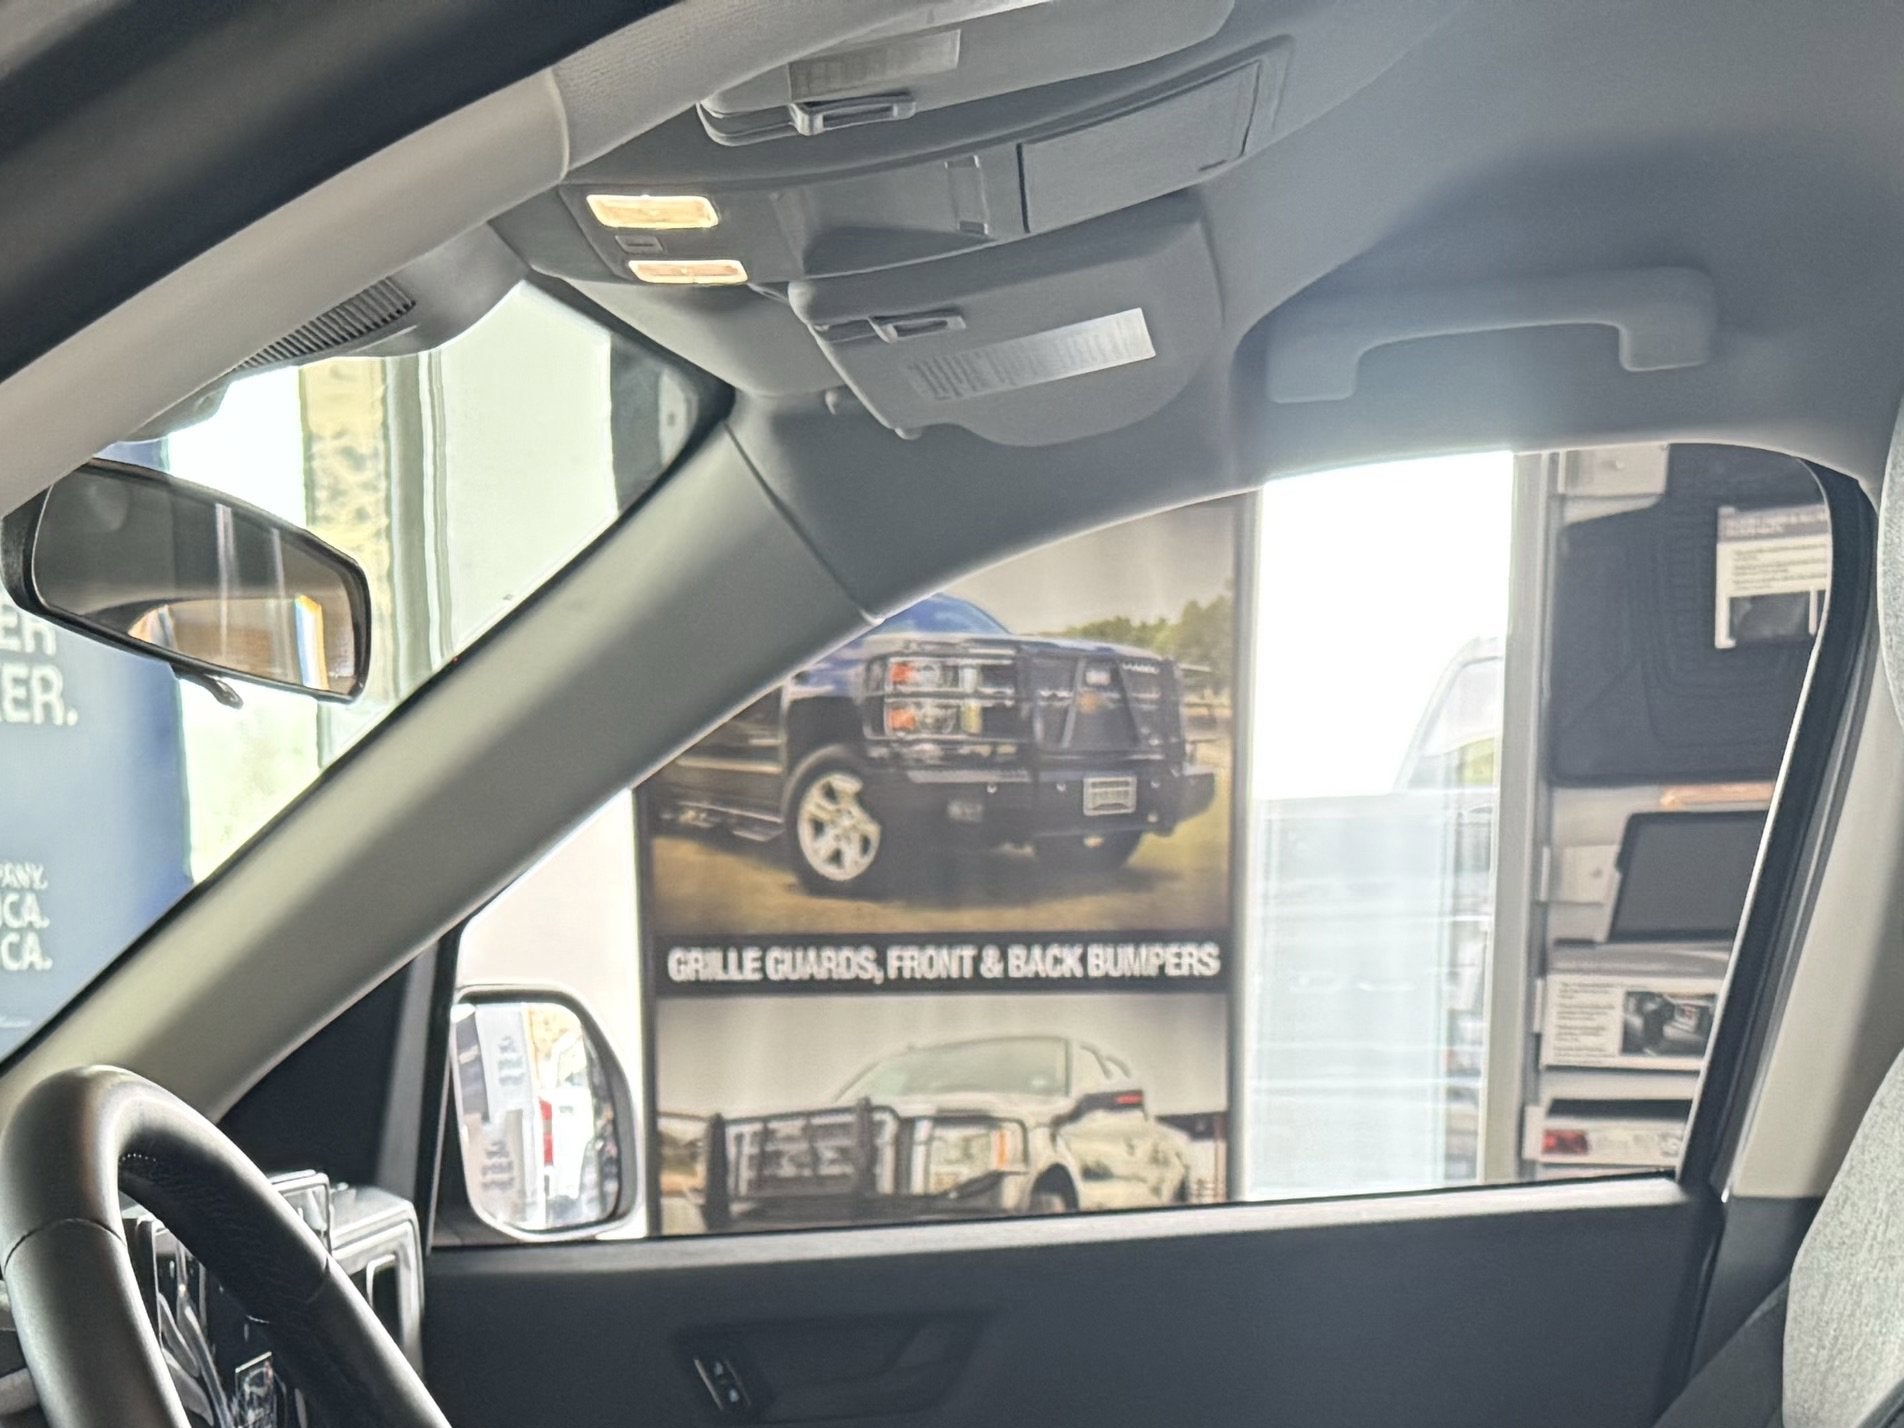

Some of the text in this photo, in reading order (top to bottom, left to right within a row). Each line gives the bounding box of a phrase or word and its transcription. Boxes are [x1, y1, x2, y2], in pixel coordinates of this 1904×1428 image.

[667, 942, 1222, 985] GRILLE GUARDS, FRONT & BACK BUMPERS
